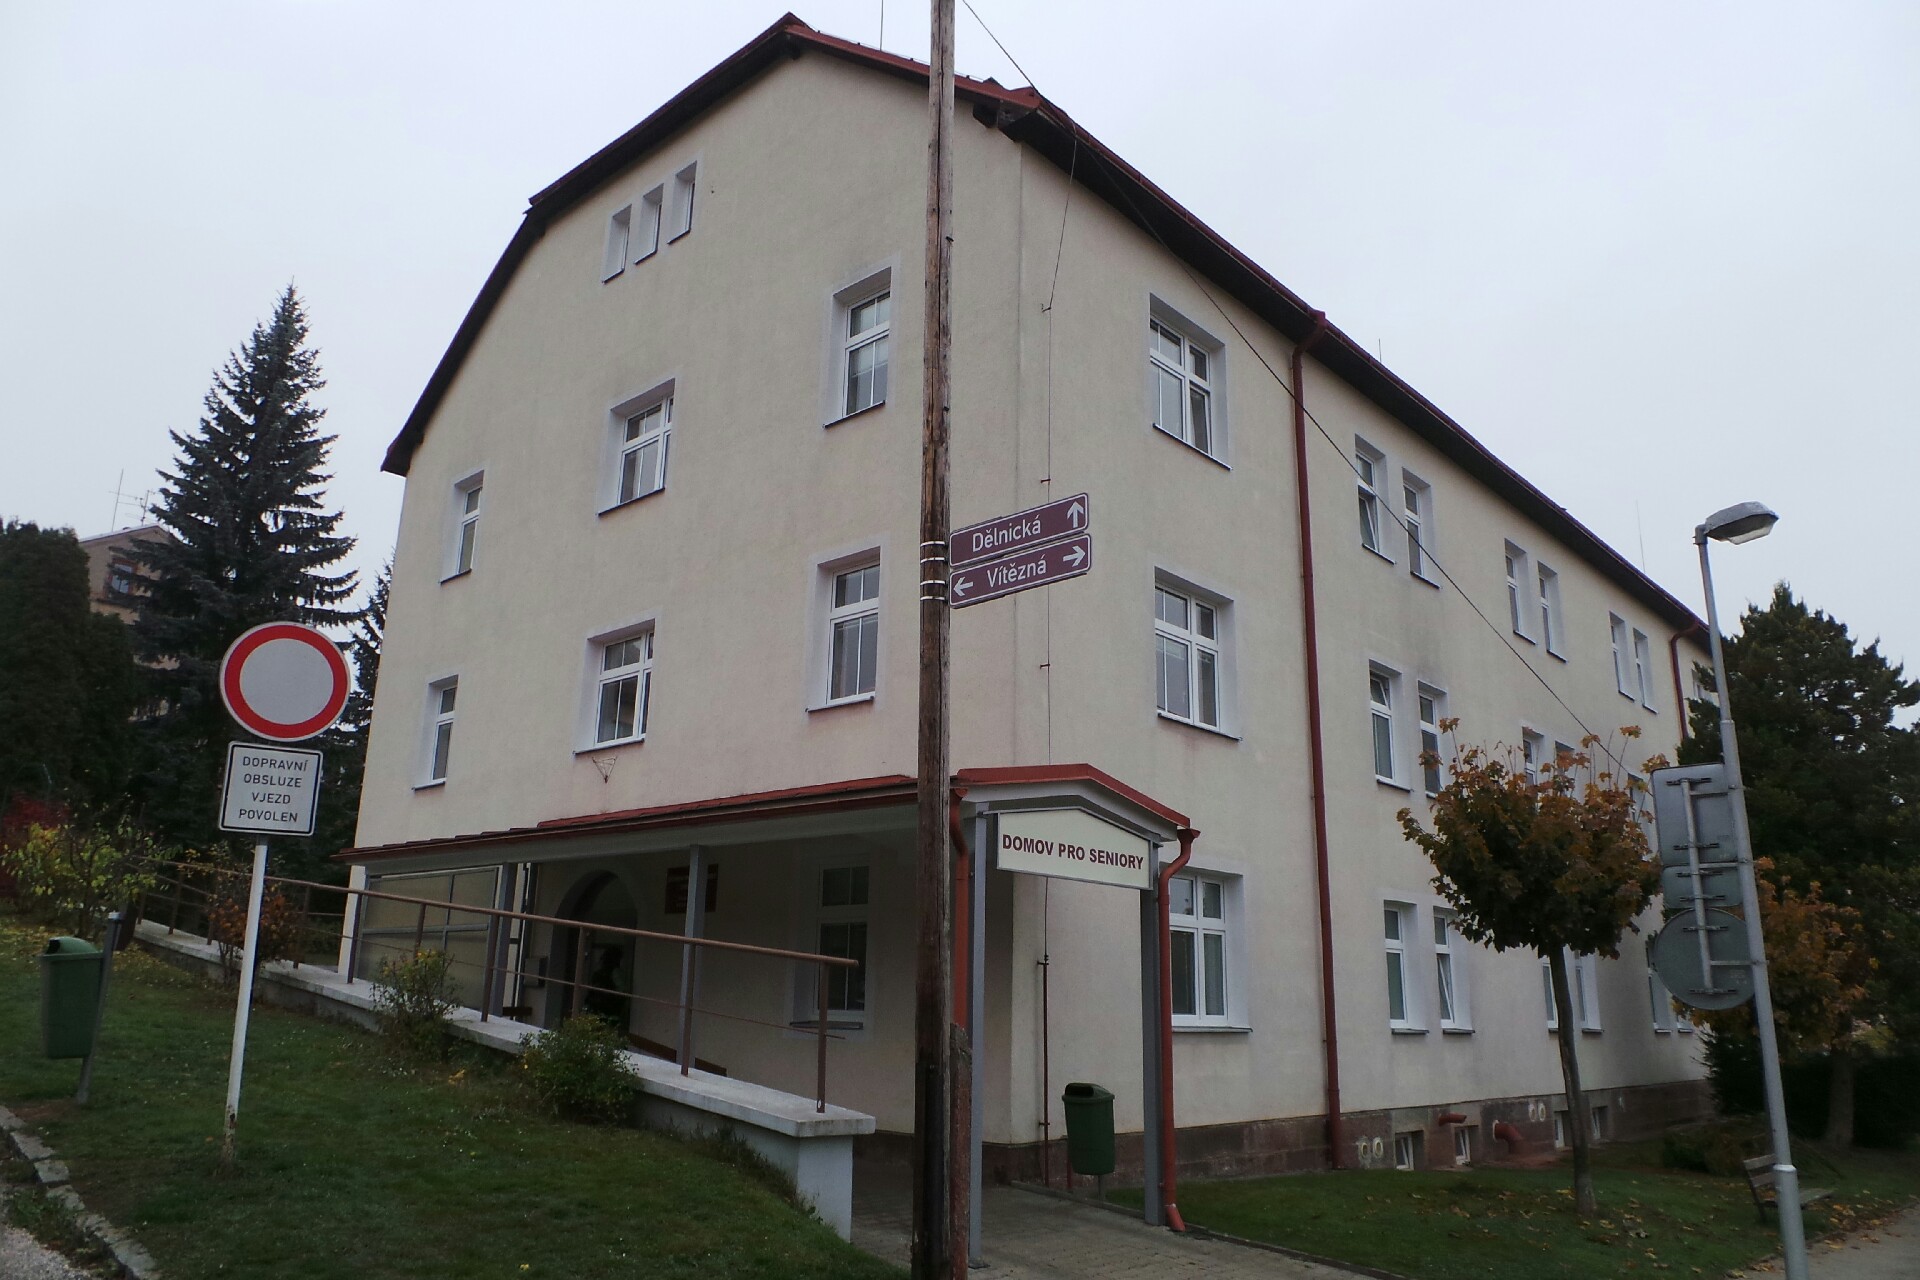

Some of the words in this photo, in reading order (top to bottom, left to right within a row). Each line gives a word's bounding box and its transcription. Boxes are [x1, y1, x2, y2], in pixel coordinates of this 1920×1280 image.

[972, 514, 1041, 552] Dělnická
[987, 554, 1047, 588] Vítězná
[242, 756, 309, 771] DOPRAVNÍ
[243, 773, 302, 787] OBSLUZE
[252, 792, 291, 804] VJEZD
[238, 808, 298, 822] POVOLEN
[1002, 834, 1054, 855] DOMOV
[1058, 843, 1085, 860] PRO
[1089, 848, 1144, 870] SENIORY
